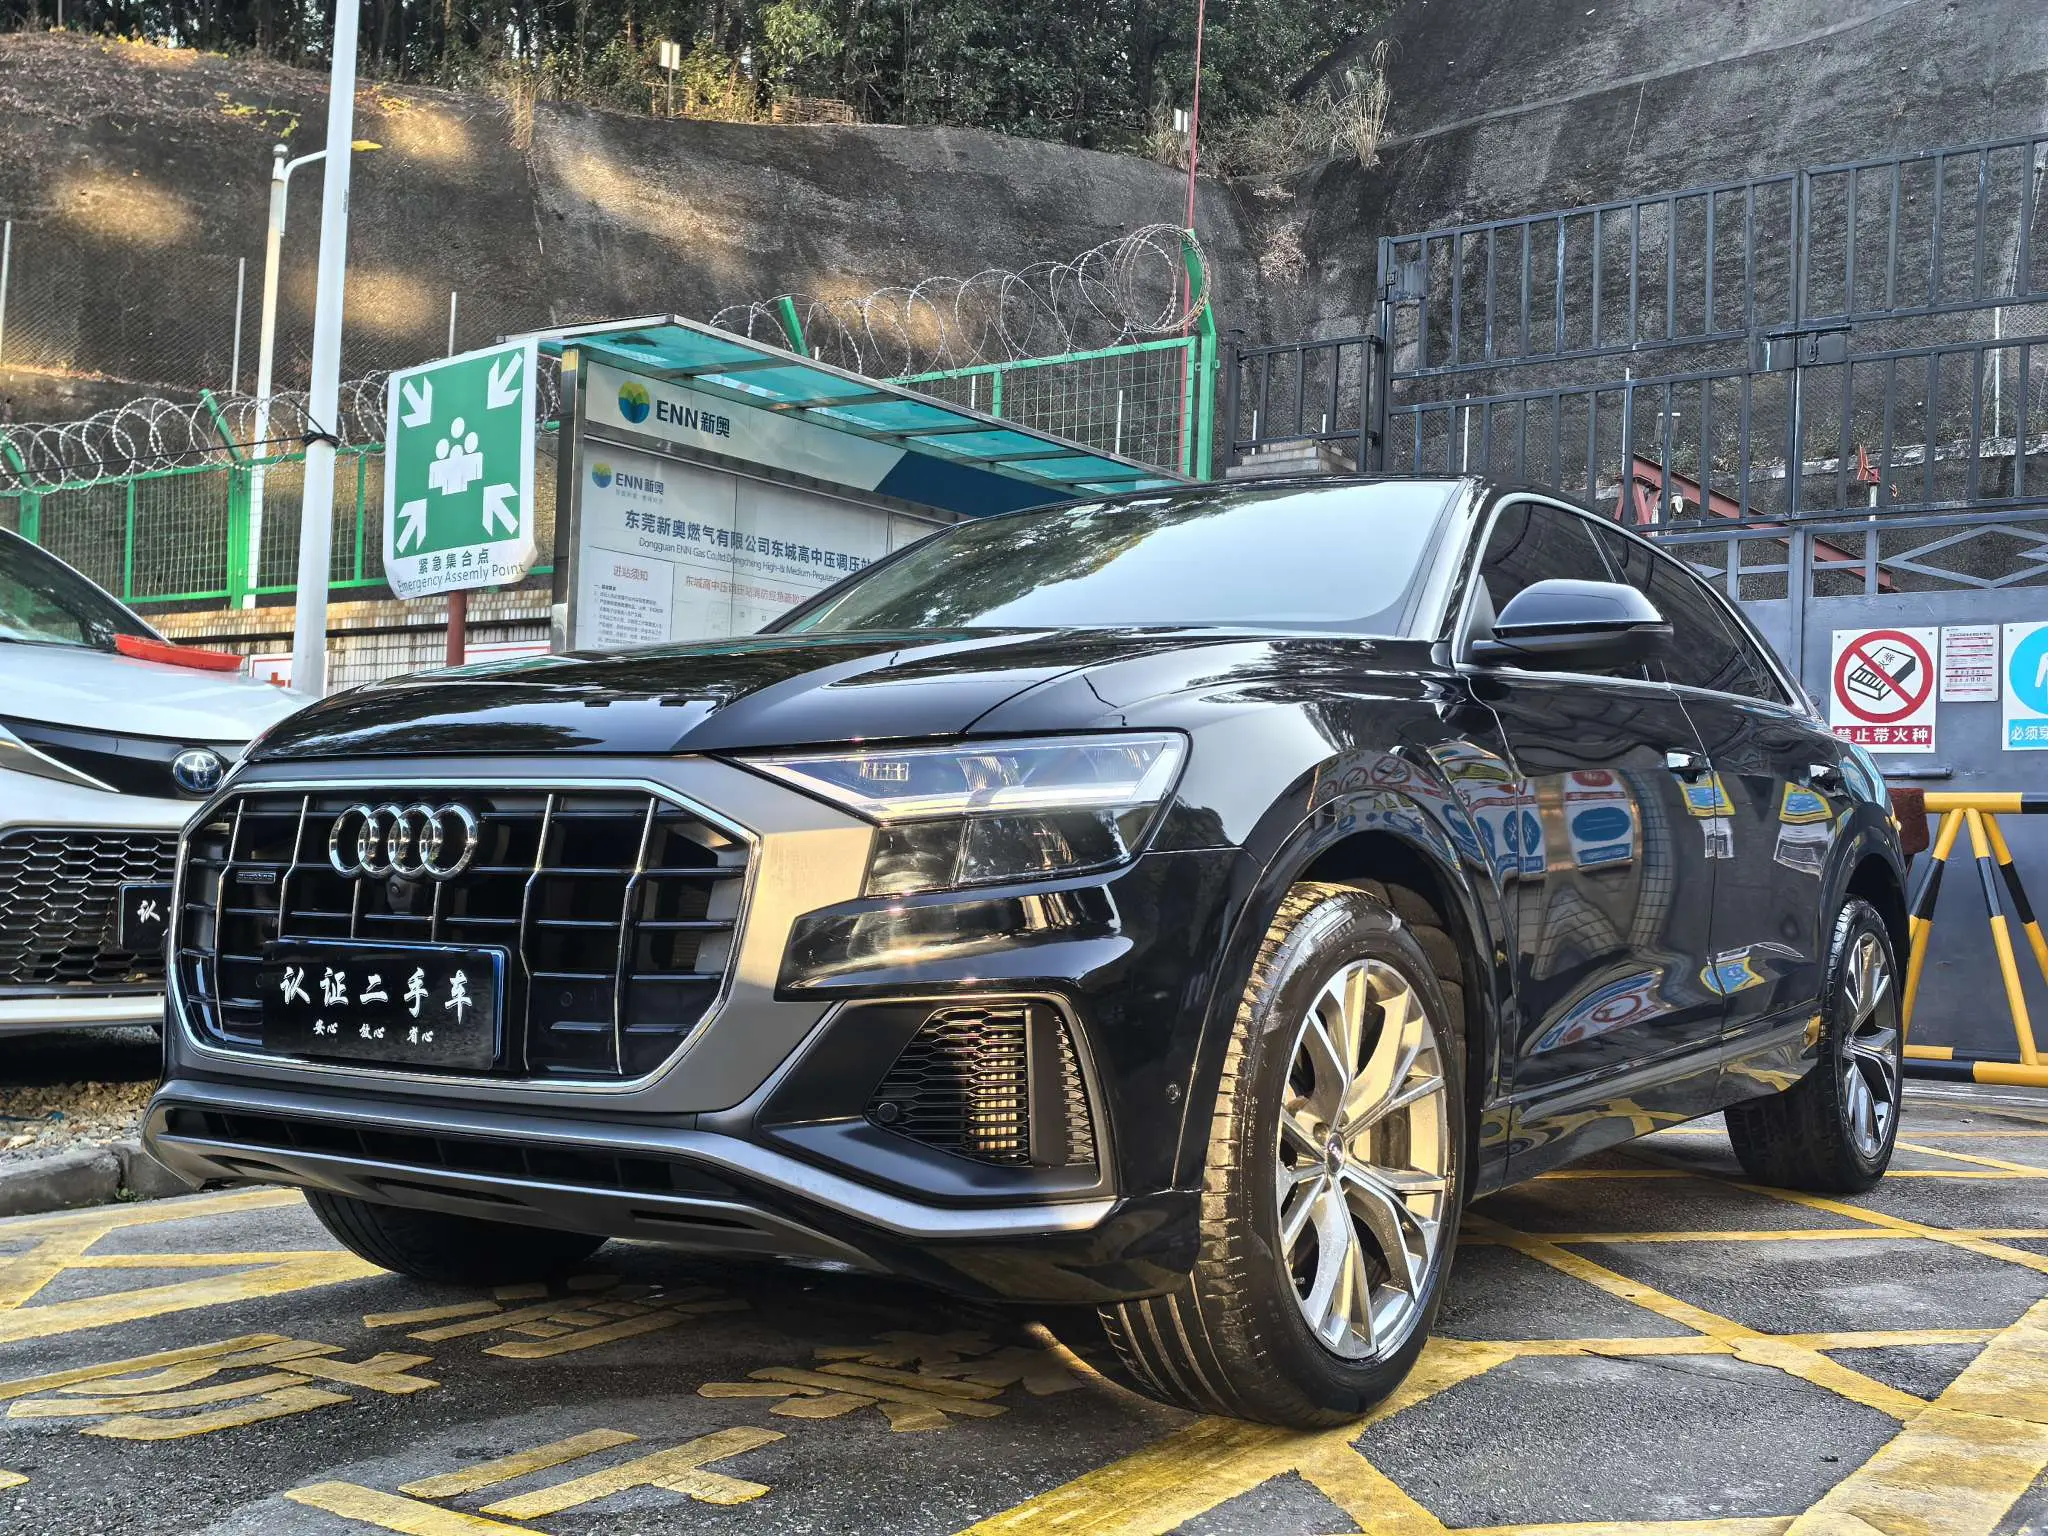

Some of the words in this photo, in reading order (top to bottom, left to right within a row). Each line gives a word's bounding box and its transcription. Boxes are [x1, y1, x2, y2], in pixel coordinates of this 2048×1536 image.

[397, 573, 443, 593] Emergency
[445, 564, 489, 583] Assemly
[492, 563, 527, 577] Point
[279, 966, 473, 1025] 认证二手车
[313, 1018, 339, 1036] 安心
[359, 1023, 386, 1040] 放心
[406, 1026, 434, 1046] 省心
